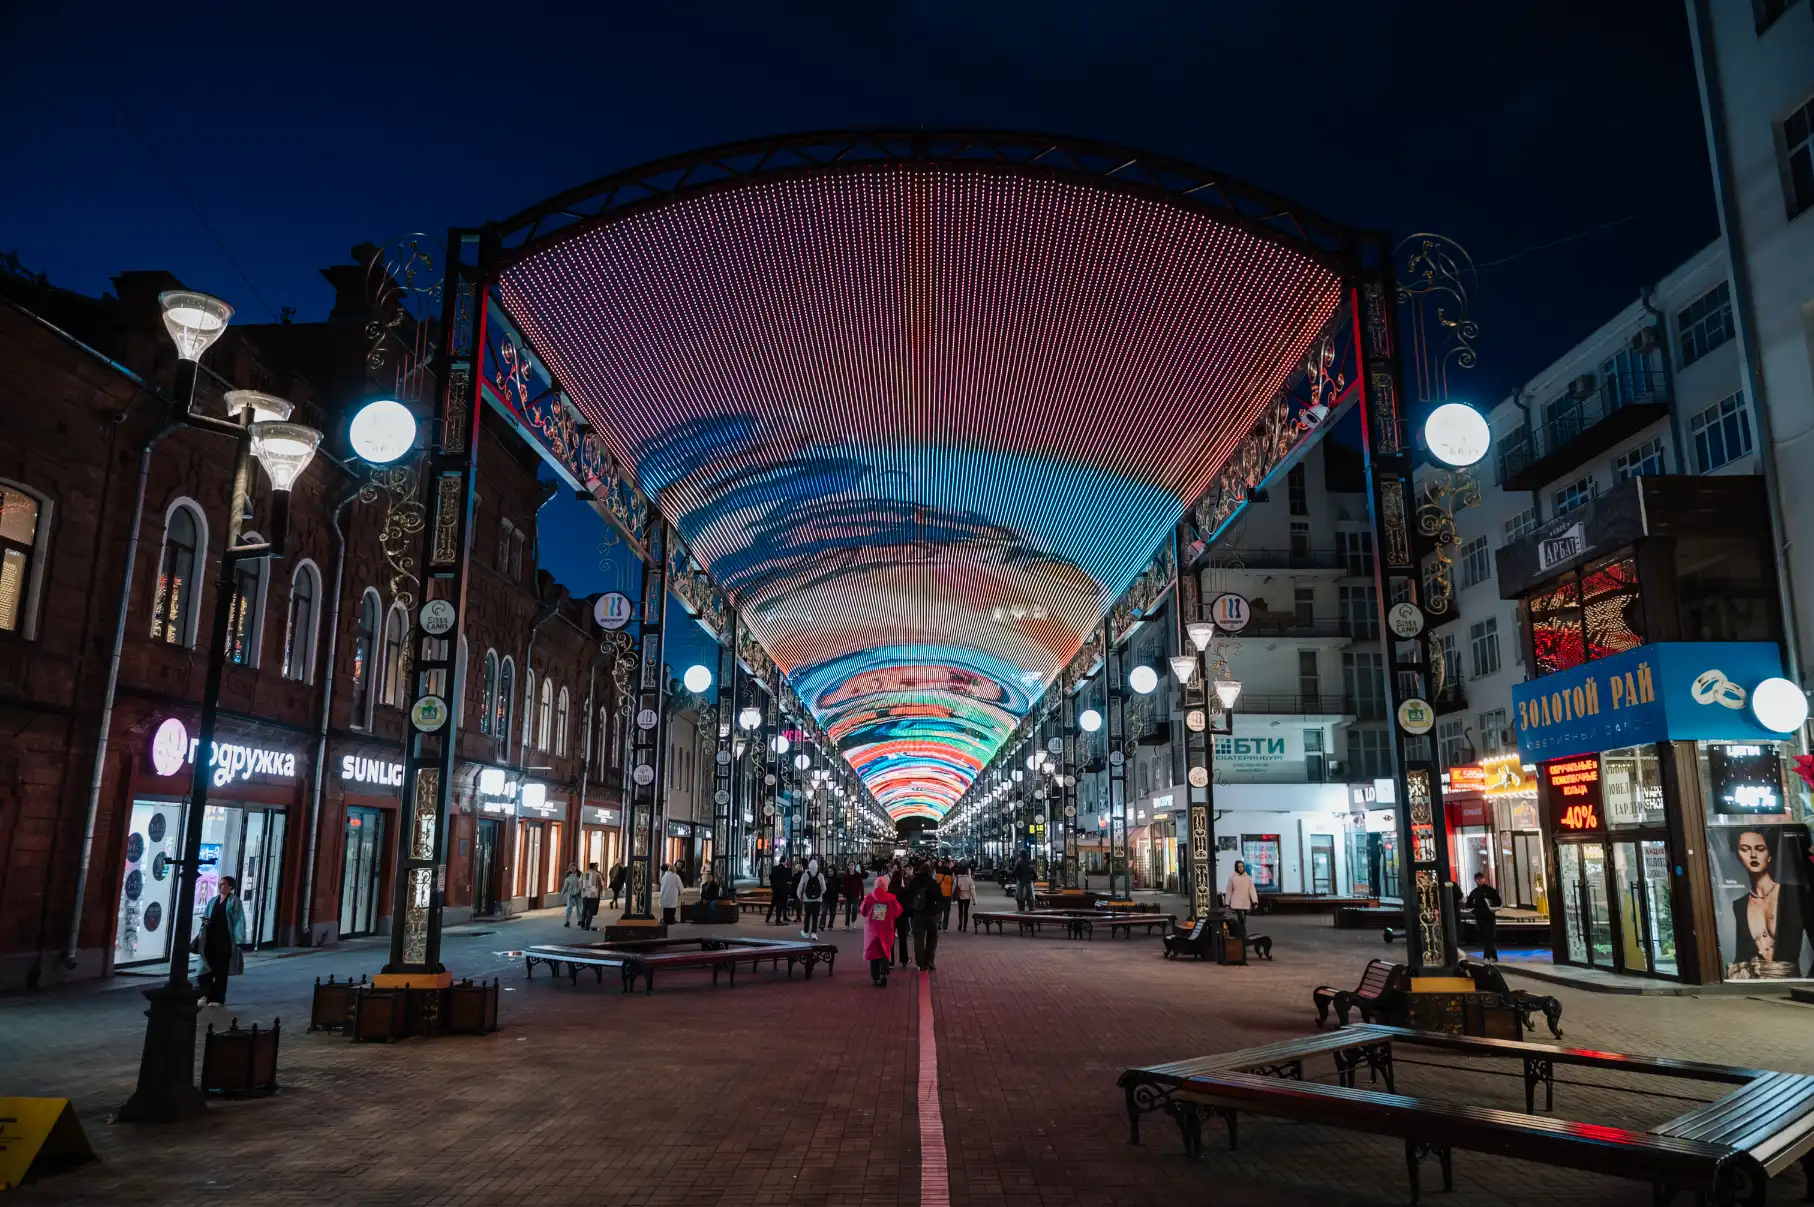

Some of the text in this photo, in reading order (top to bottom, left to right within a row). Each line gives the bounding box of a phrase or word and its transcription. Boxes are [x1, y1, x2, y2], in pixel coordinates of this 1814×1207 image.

[1546, 537, 1576, 566] АРБАТ
[427, 623, 449, 631] LAND
[1518, 661, 1656, 732] ЗОЛОТОЙ РАЙ
[1233, 737, 1285, 754] БТИ
[341, 755, 406, 787] SUNLIG
[1549, 760, 1592, 775] ОБРУЧАЛЬНЫЕ
[1552, 771, 1598, 786] ПОМОЛВОЧНЫЕ
[1563, 784, 1588, 796] КОЛЬЦА
[1560, 804, 1597, 829] -40%
